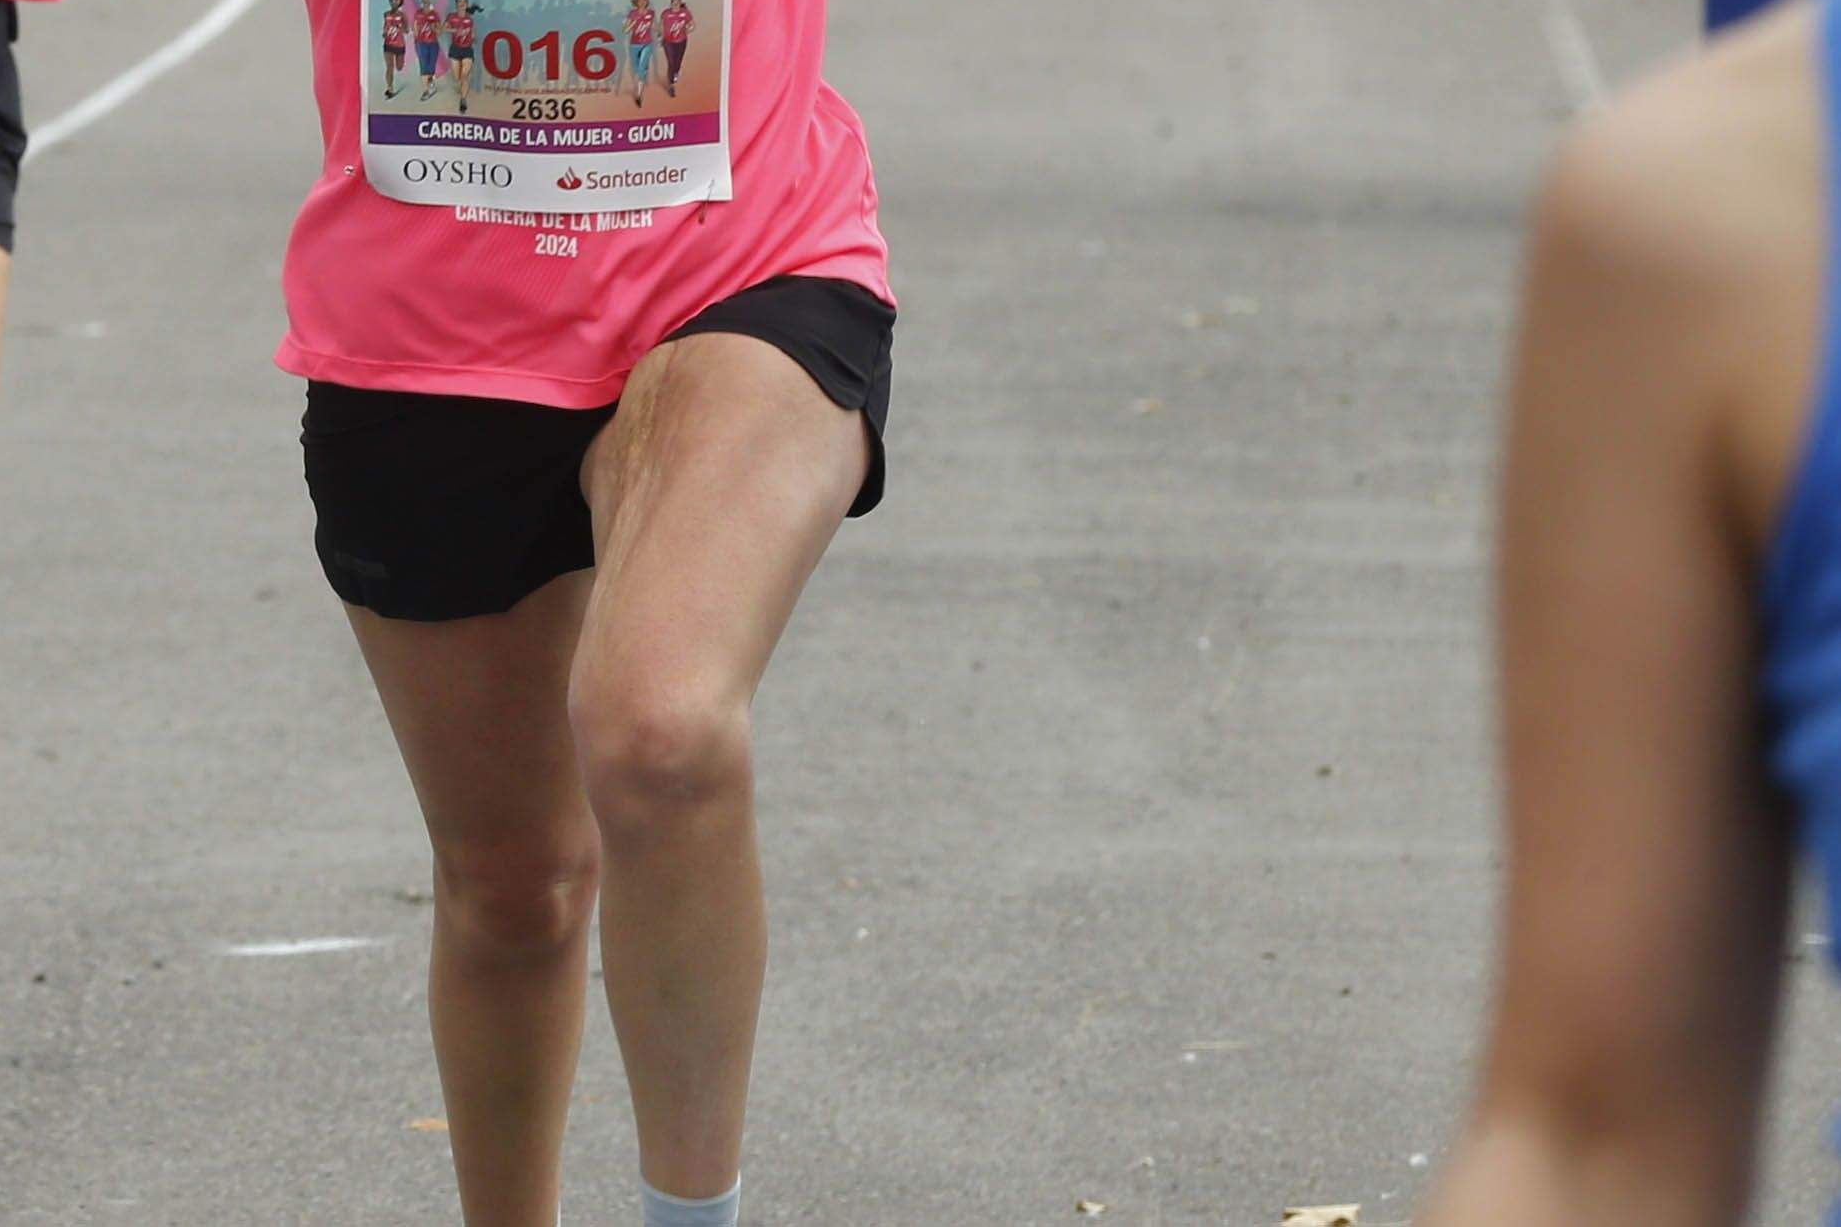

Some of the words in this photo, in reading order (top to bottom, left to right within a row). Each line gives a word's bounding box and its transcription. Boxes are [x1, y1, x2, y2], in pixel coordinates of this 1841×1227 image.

[481, 29, 618, 82] 016
[512, 97, 577, 121] 2636
[418, 121, 495, 142] CARRERA
[500, 127, 520, 146] DE
[526, 128, 548, 147] LA
[553, 128, 613, 147] MUJER
[628, 119, 675, 143] GIJÓN
[403, 158, 513, 189] OYSHO
[586, 165, 687, 190] Santander
[542, 213, 565, 230] DE
[570, 213, 592, 232] LA
[596, 209, 654, 233] MUJER
[535, 233, 579, 258] 2024
